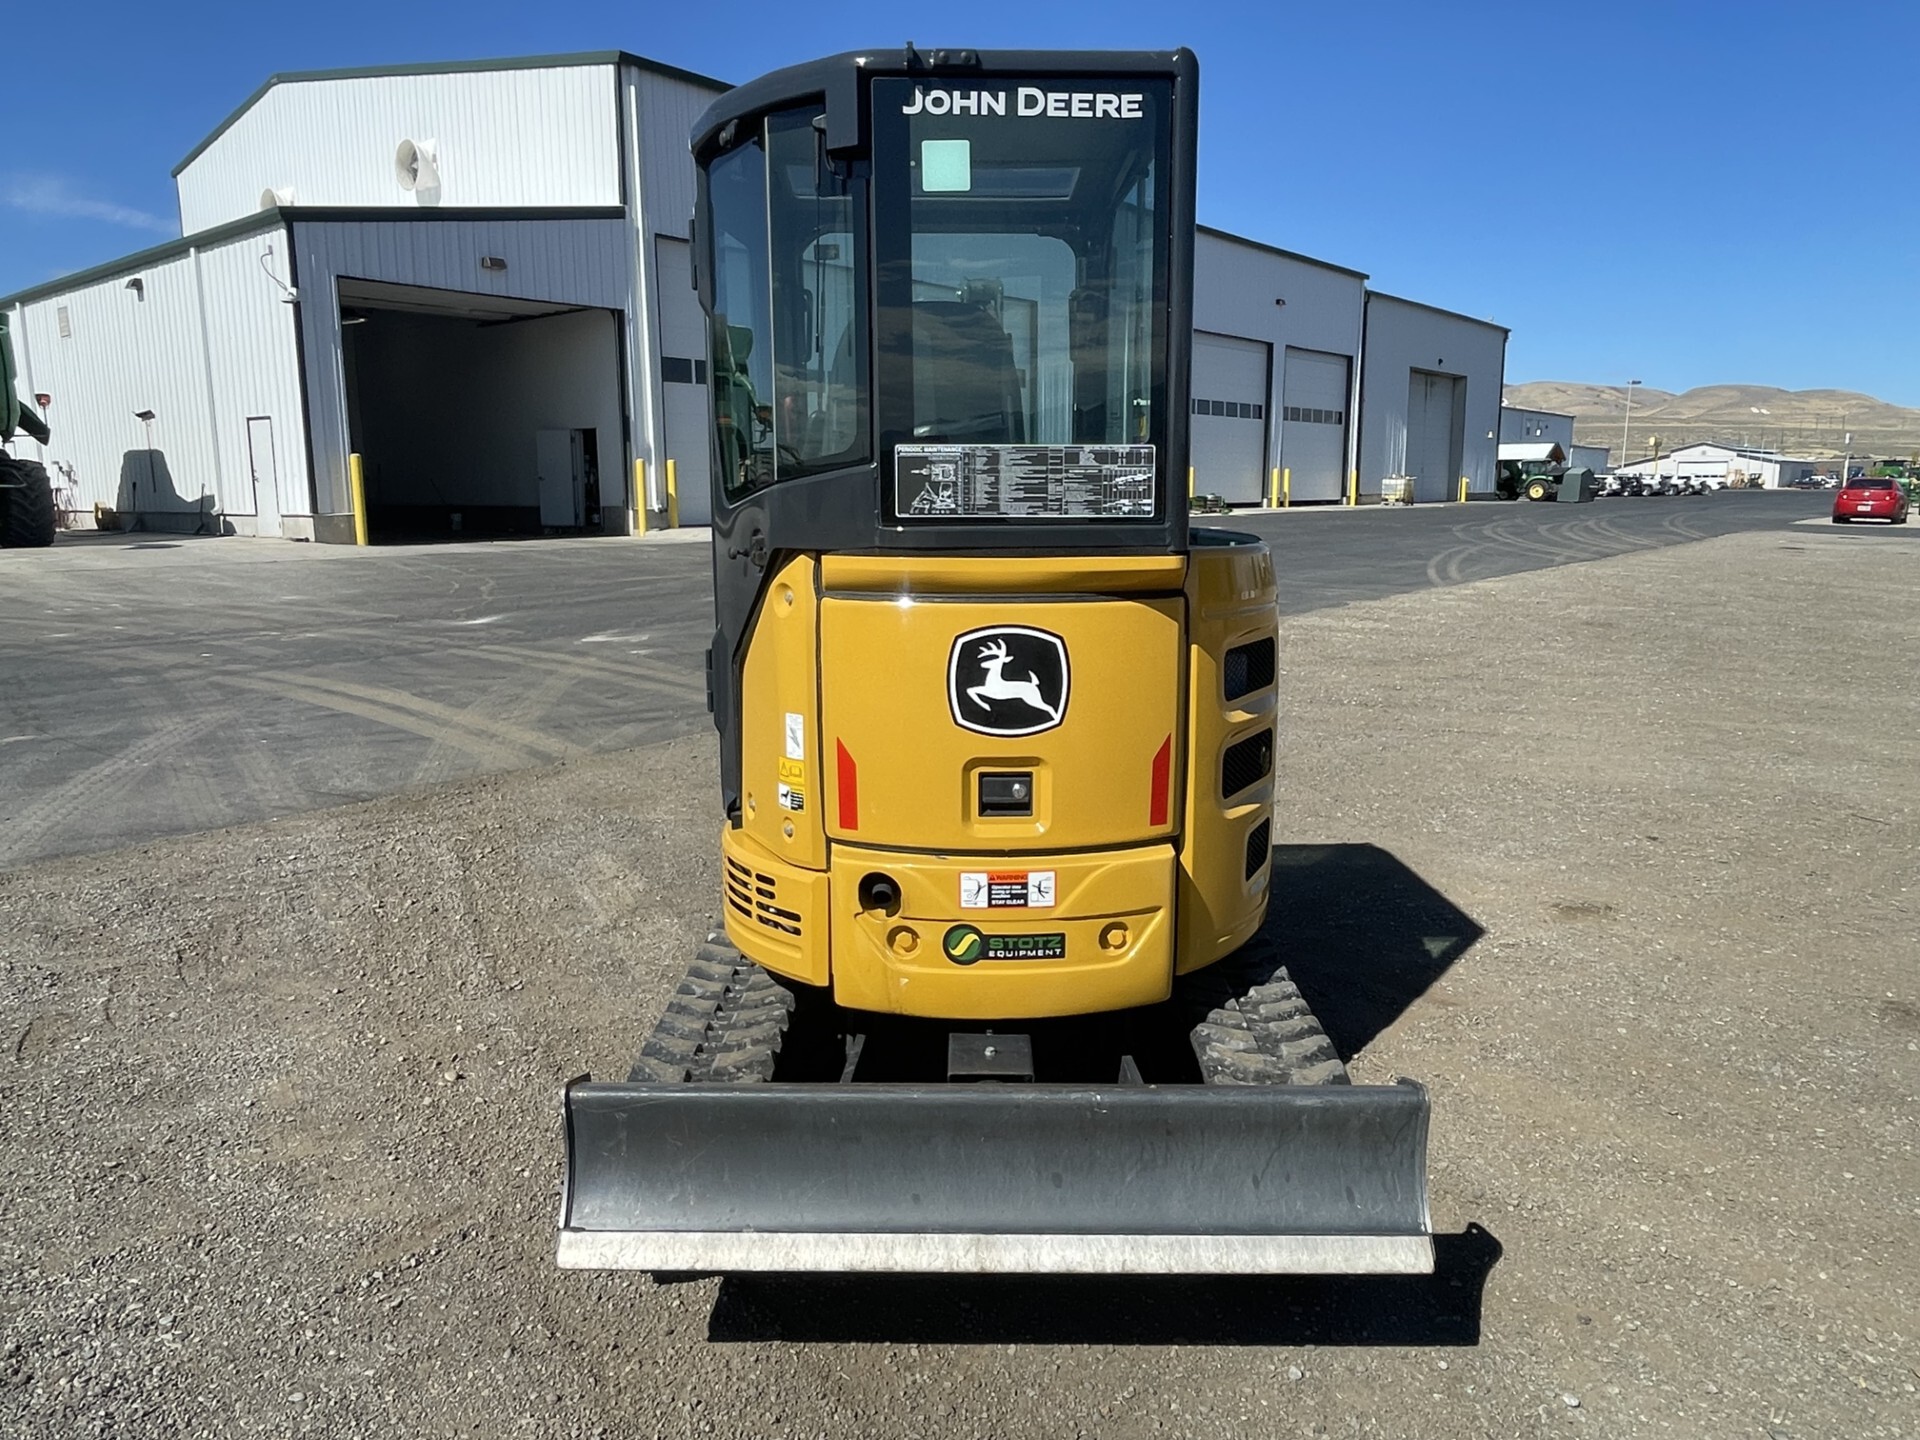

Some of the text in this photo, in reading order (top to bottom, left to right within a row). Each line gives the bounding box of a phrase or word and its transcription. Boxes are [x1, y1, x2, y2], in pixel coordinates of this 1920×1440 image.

[902, 86, 1143, 119] JOHN DEERE
[989, 937, 1061, 949] STOTZ
[988, 948, 1062, 958] EQUIPMENT
